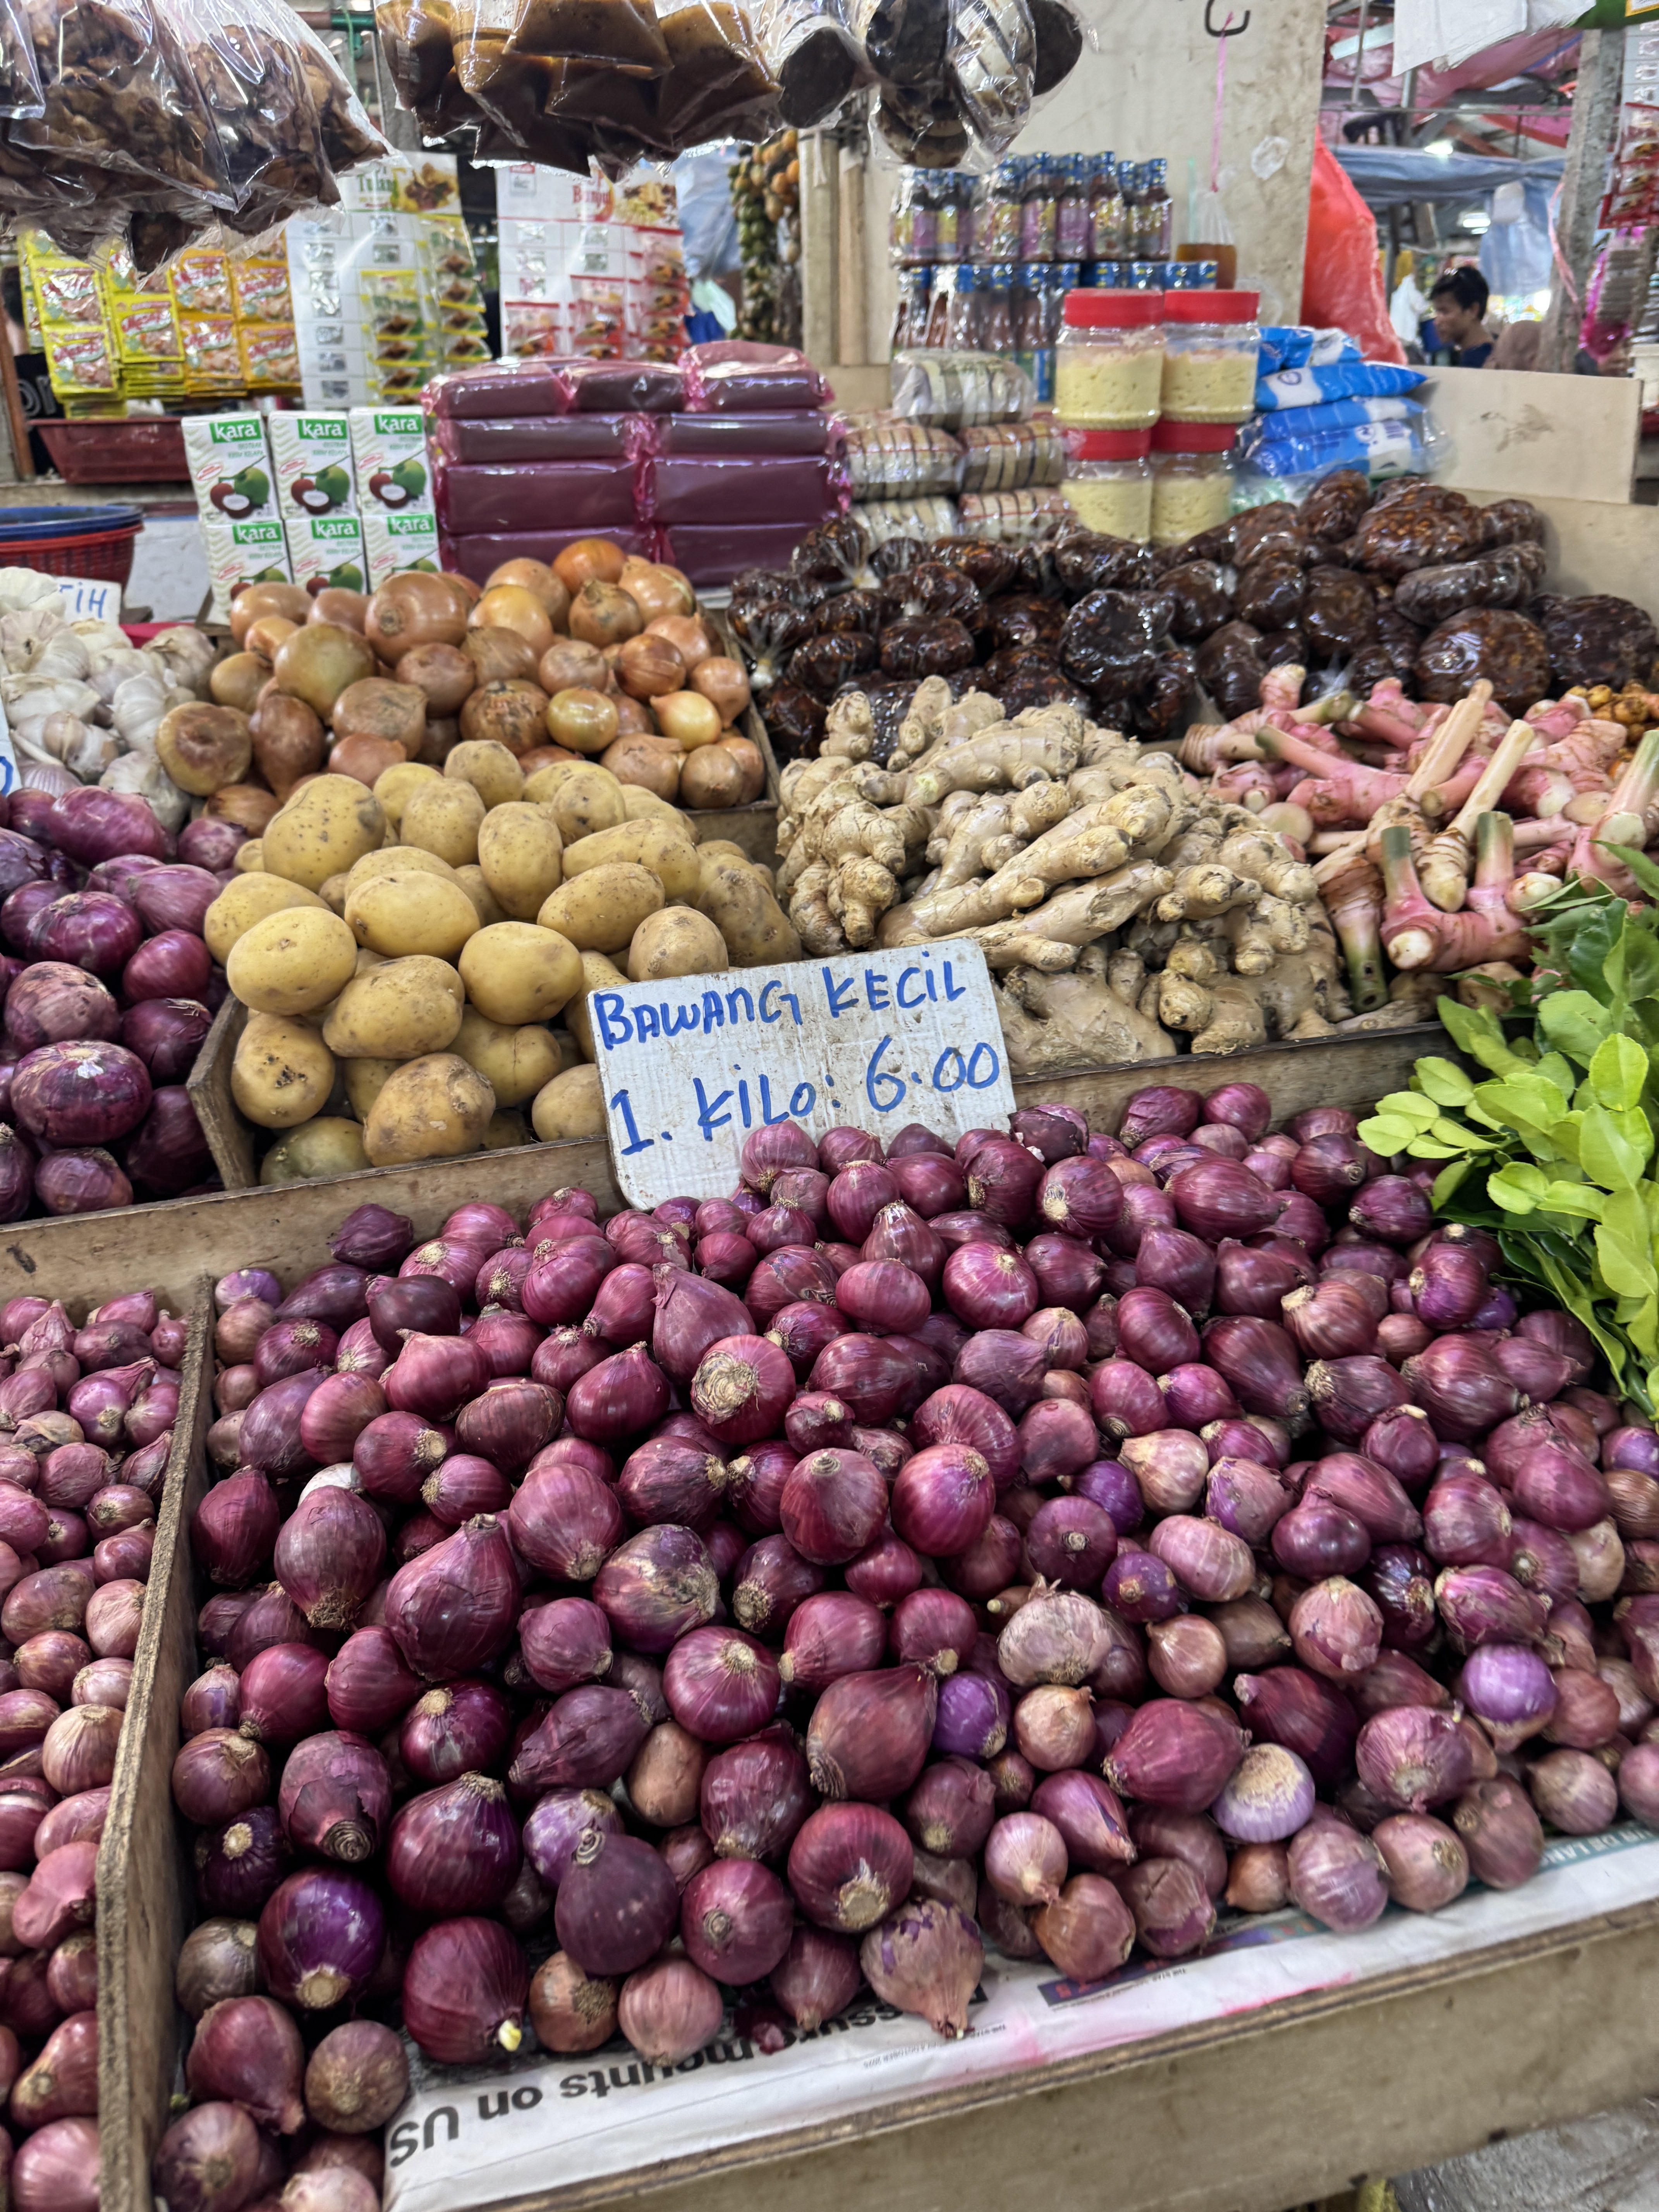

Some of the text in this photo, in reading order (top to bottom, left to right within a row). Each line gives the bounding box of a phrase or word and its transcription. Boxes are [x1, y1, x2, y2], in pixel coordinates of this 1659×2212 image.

[214, 422, 257, 442] kara
[302, 419, 343, 439] kara
[378, 414, 419, 434] kara
[237, 525, 278, 544] kara
[315, 520, 356, 539] kara
[391, 516, 431, 535] kara
[594, 980, 803, 1051] BAWANG
[867, 1035, 1000, 1113] 6.00
[478, 2087, 543, 2120] on
[390, 2106, 459, 2167] US
